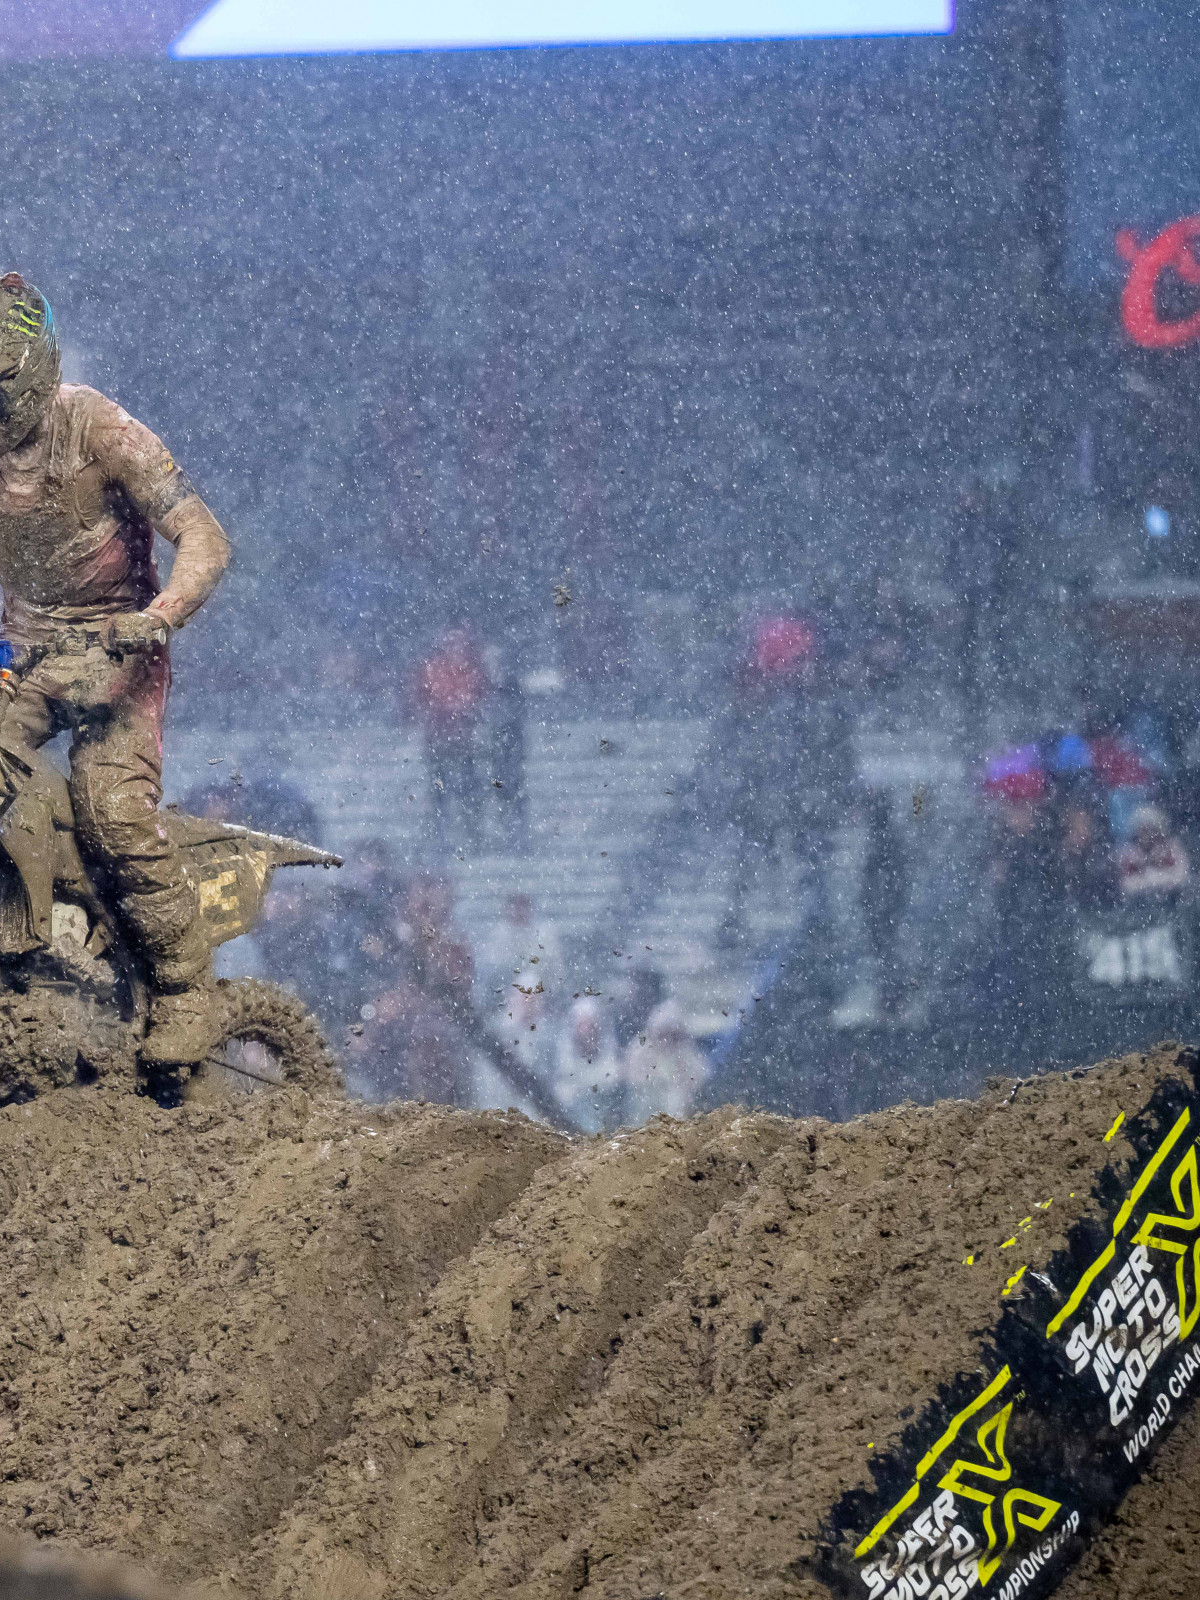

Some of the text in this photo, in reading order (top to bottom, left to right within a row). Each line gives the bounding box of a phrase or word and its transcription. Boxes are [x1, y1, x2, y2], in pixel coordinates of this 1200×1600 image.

[1065, 1244, 1154, 1376] SUPER
[1093, 1278, 1166, 1394] MOTO
[1109, 1303, 1181, 1427] CROSS
[1122, 1392, 1171, 1464] WORLD
[990, 1510, 1080, 1600] MPIONSHIP
